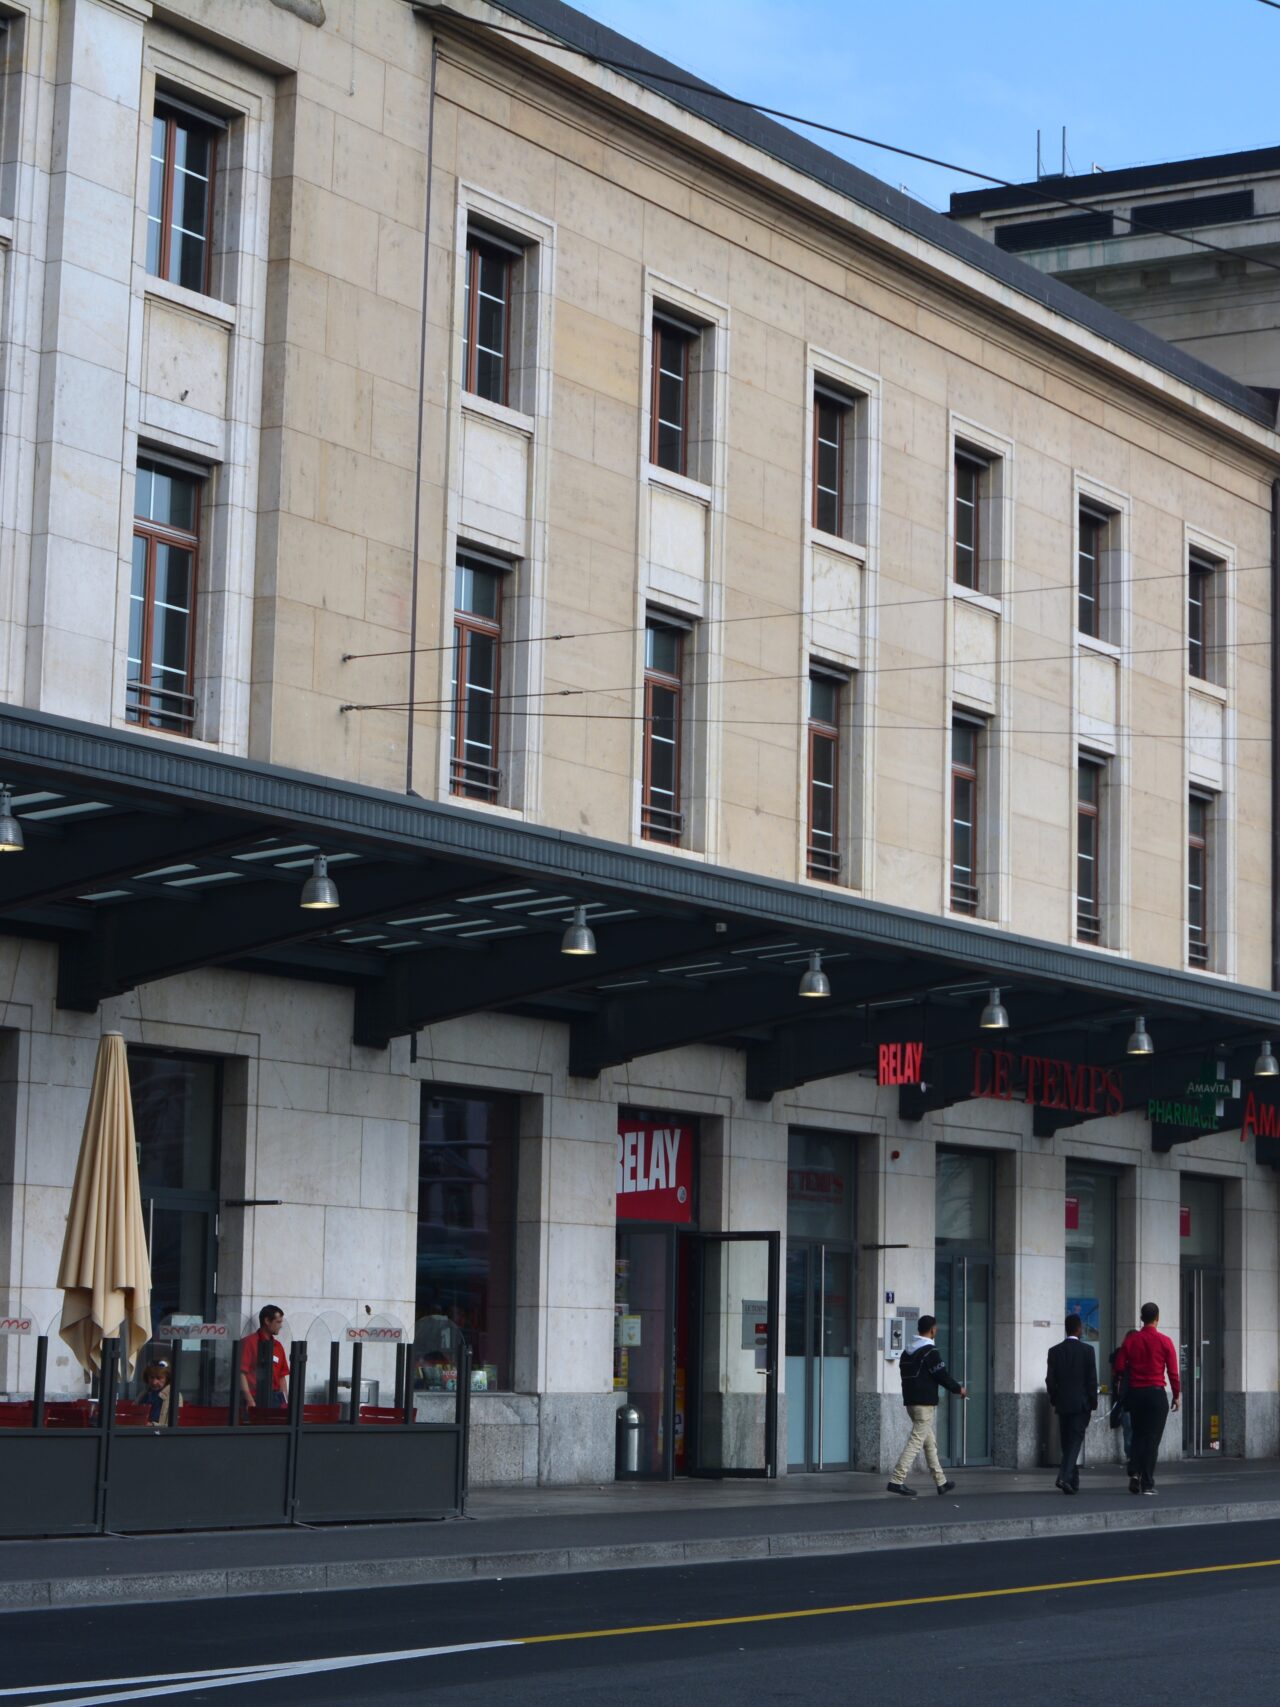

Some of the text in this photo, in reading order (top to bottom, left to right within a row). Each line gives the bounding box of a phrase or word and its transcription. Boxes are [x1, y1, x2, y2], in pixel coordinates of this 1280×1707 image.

[879, 1042, 923, 1085] RELAY
[970, 1047, 1124, 1117] LE TEMPS
[1187, 1081, 1231, 1094] AMAVITA
